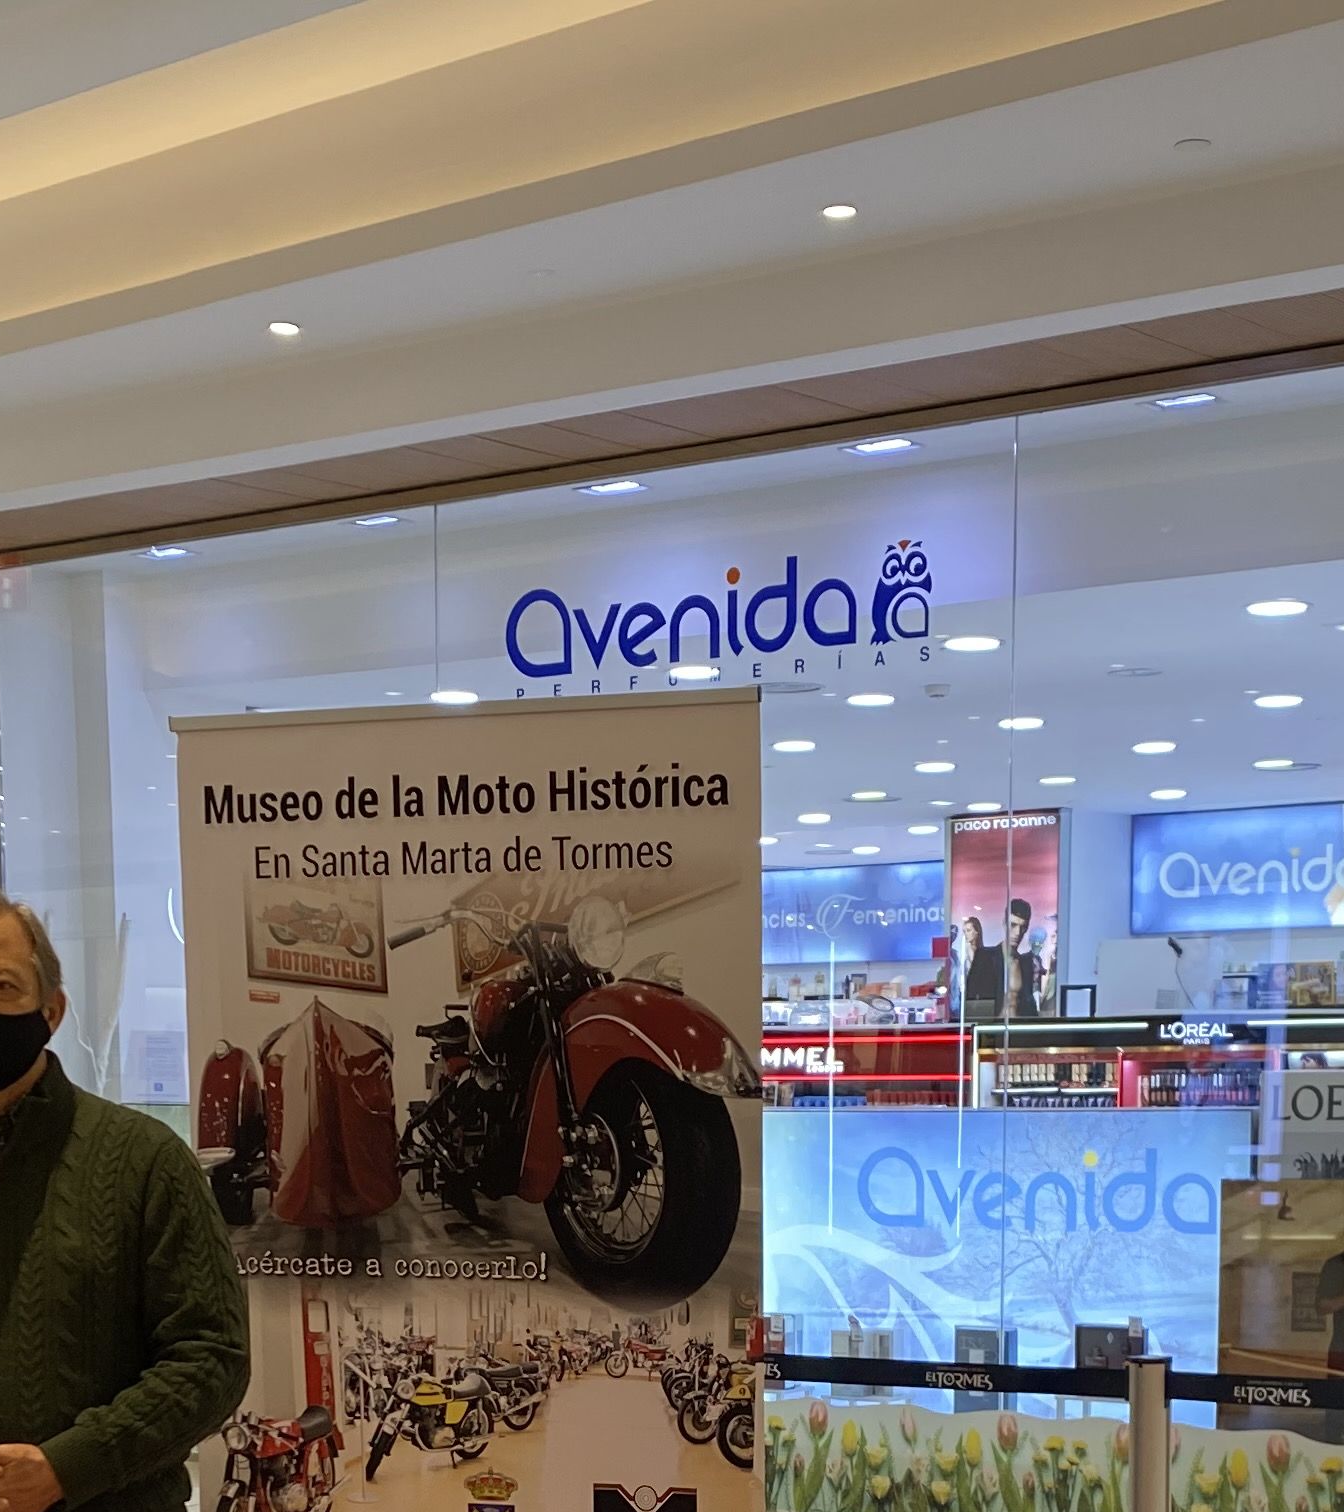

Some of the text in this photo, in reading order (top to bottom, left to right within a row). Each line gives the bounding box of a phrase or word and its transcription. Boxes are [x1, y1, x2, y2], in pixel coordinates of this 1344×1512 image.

[203, 761, 729, 824] Museo de la Moto Histórica
[953, 818, 991, 834] paco
[254, 835, 674, 880] En Santa Marta de Tormes
[266, 947, 376, 982] MOTORCYCLES
[365, 1257, 383, 1277] a
[394, 1251, 548, 1282] conocerlo!
